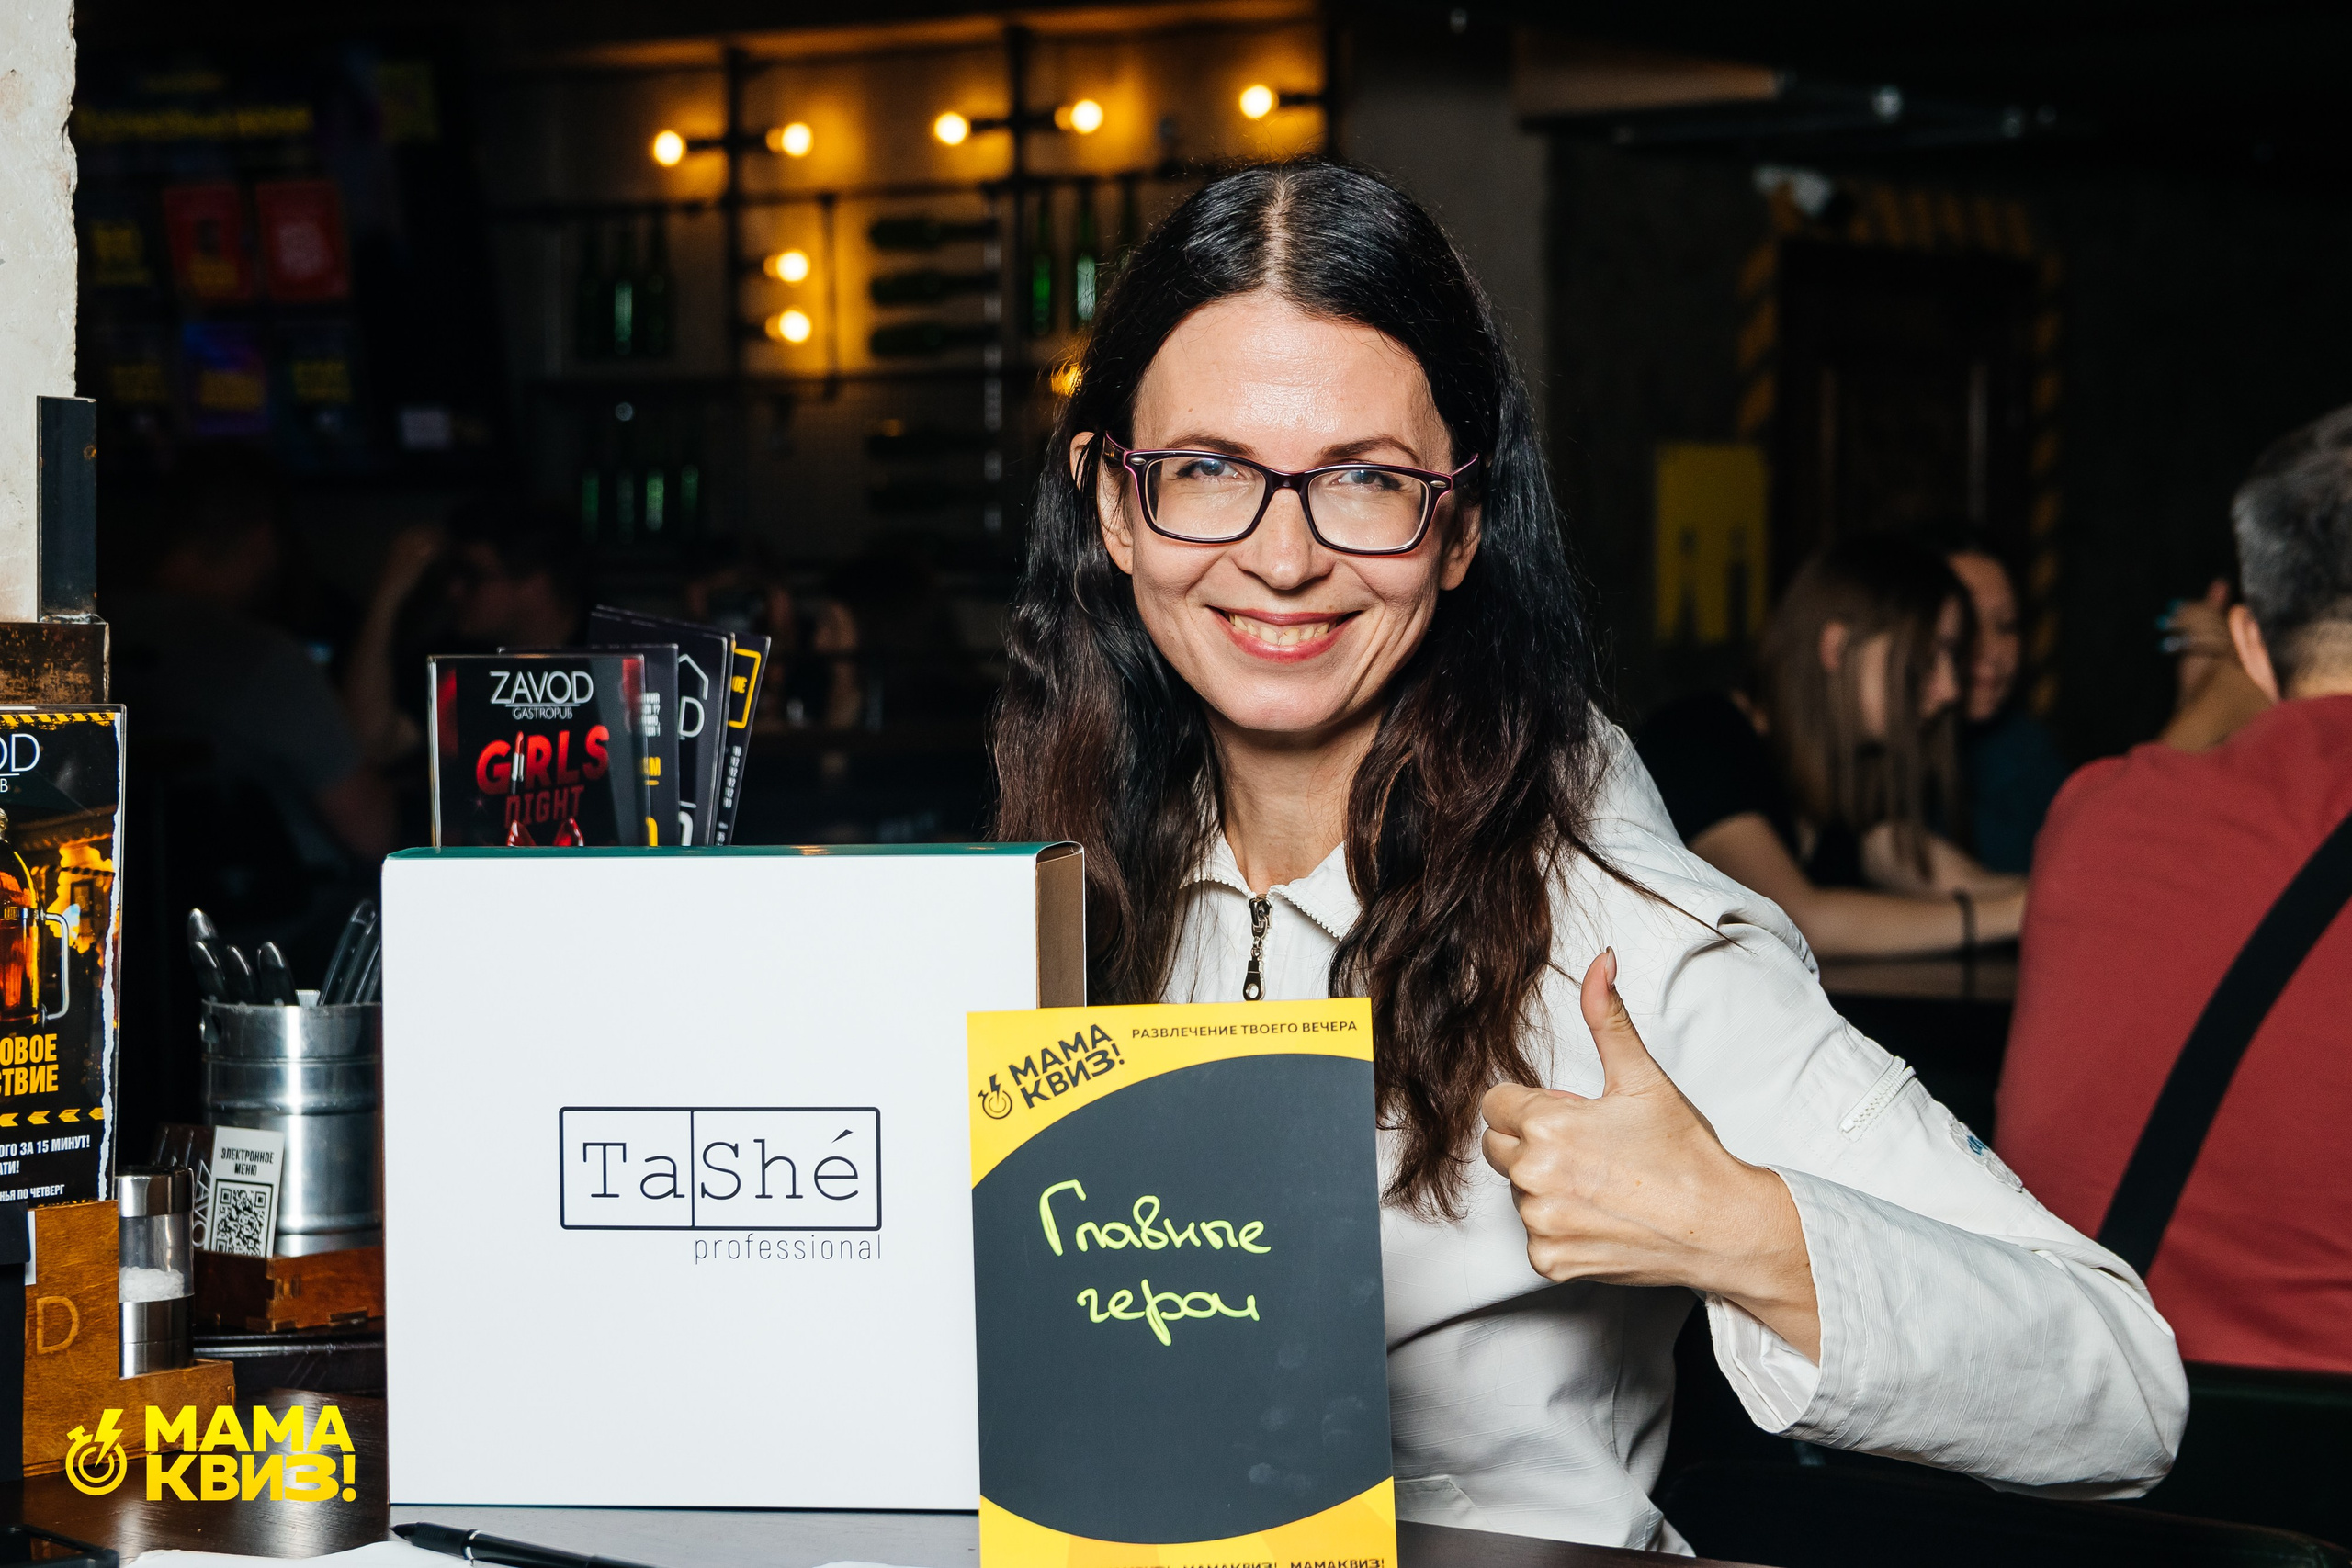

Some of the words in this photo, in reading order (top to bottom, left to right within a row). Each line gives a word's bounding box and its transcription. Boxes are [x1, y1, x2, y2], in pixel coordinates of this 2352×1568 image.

[490, 671, 594, 705] ZAVOD
[512, 706, 573, 720] GASTROPUB
[0, 733, 40, 772] D
[476, 724, 610, 795] GIRLS
[505, 784, 585, 829] NIGHT
[1131, 1024, 1238, 1039] РАЗВЛЕЧЕНИЕ
[1240, 1021, 1298, 1035] ТВОЕГО
[1301, 1020, 1358, 1033] ВЕЧЕРА
[0, 1033, 58, 1066] ОВОЕ
[1008, 1023, 1113, 1086] МАМА
[0, 1064, 59, 1097] ТВИЕ
[1020, 1043, 1125, 1109] КВИЗ!
[19, 1141, 34, 1156] ЗА
[37, 1139, 49, 1154] 15
[51, 1134, 90, 1152] МИНУТ!
[220, 1147, 275, 1165] ЭЛЕКТРОННОЕ
[233, 1162, 258, 1177] МЕНЮ
[17, 1188, 28, 1200] ПО
[30, 1184, 65, 1198] ЧЕТВЕРГ
[695, 1233, 881, 1265] professional
[1076, 1279, 1261, 1347] герои
